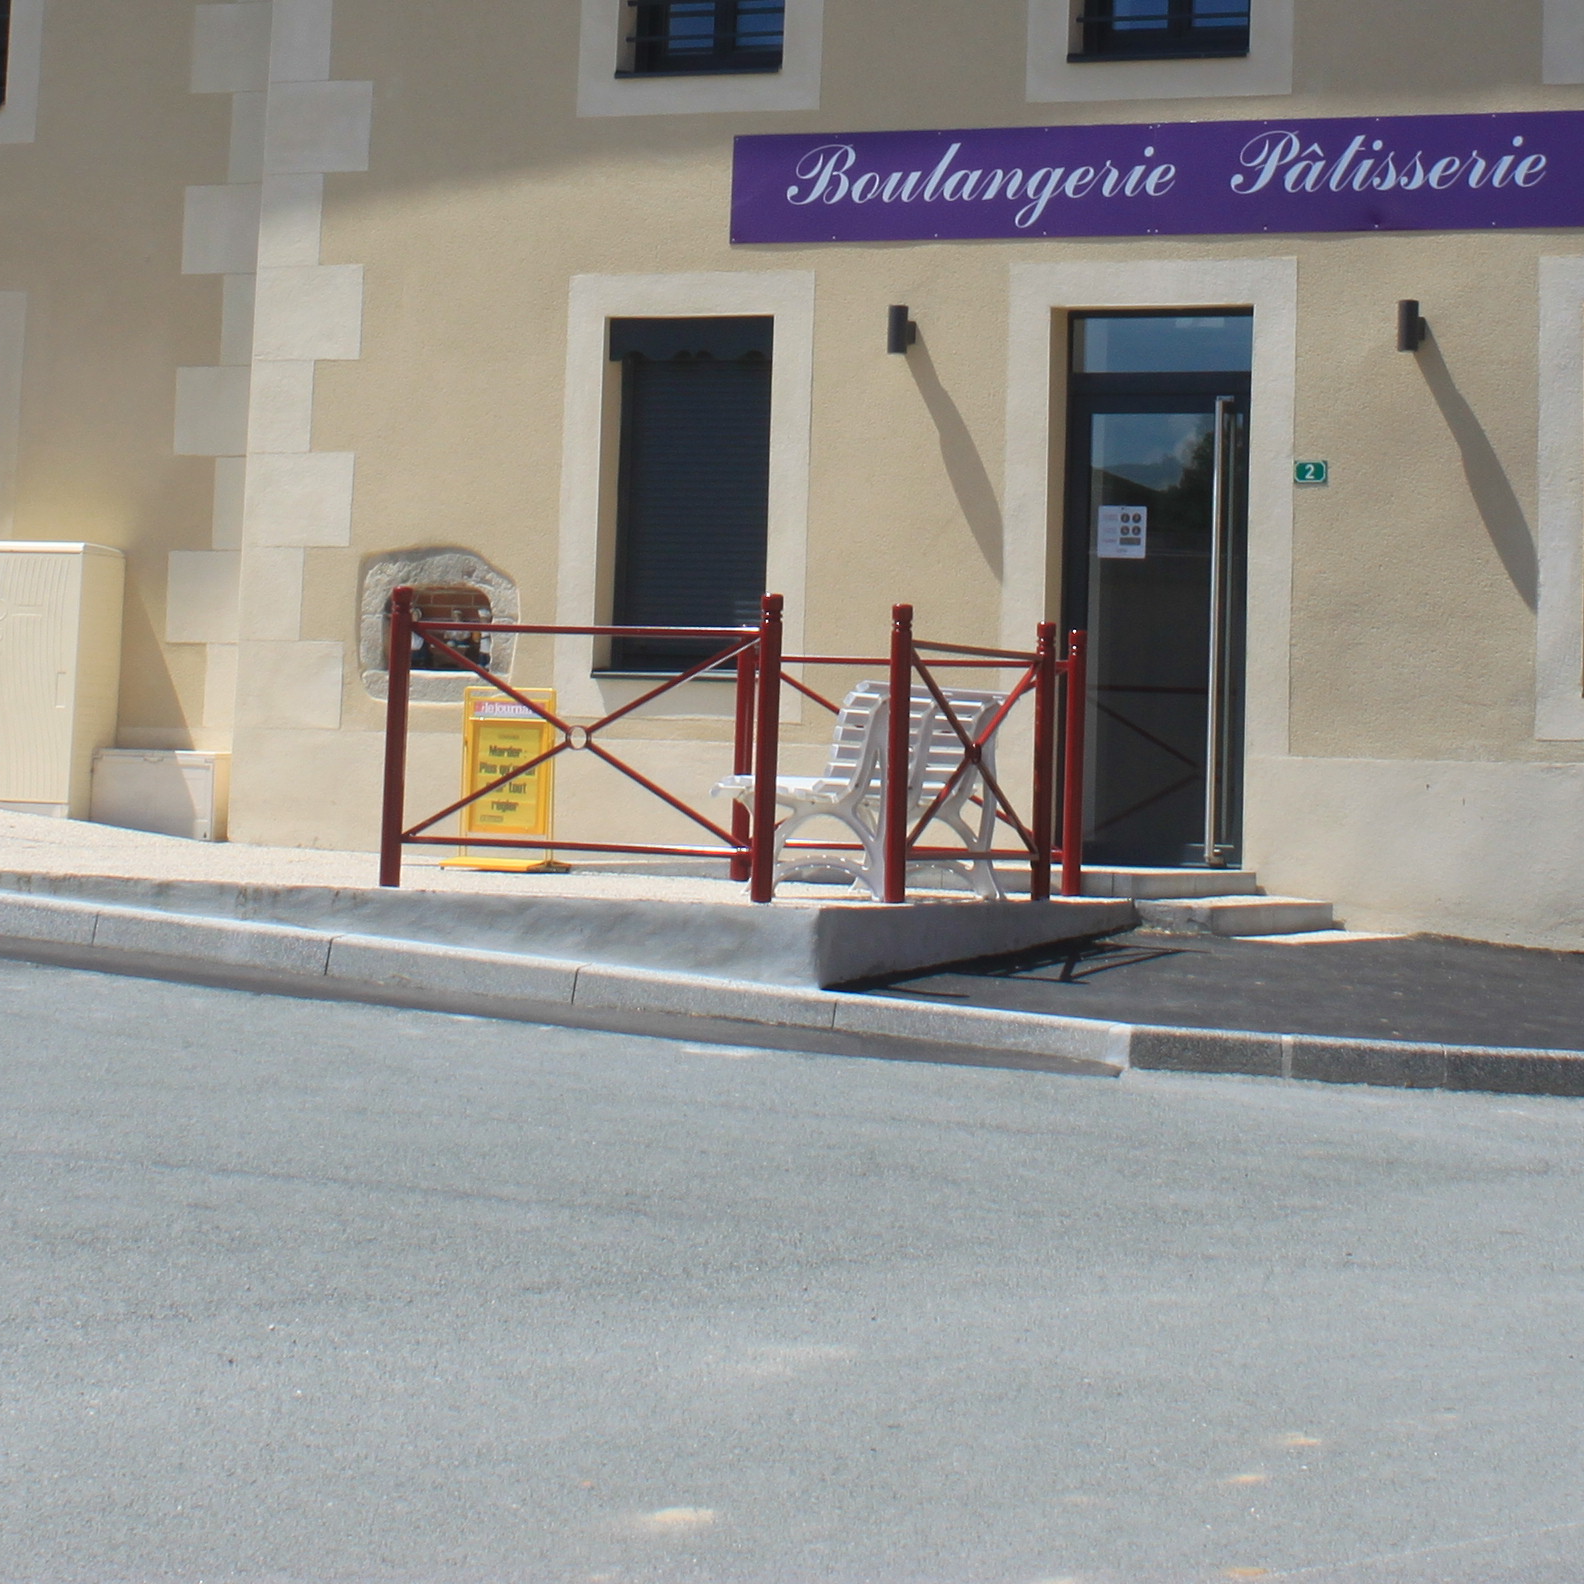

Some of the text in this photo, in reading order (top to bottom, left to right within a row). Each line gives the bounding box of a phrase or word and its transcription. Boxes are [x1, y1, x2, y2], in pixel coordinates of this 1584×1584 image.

[787, 130, 1547, 228] Boulangerie Pâtisserie
[1305, 464, 1315, 479] 2
